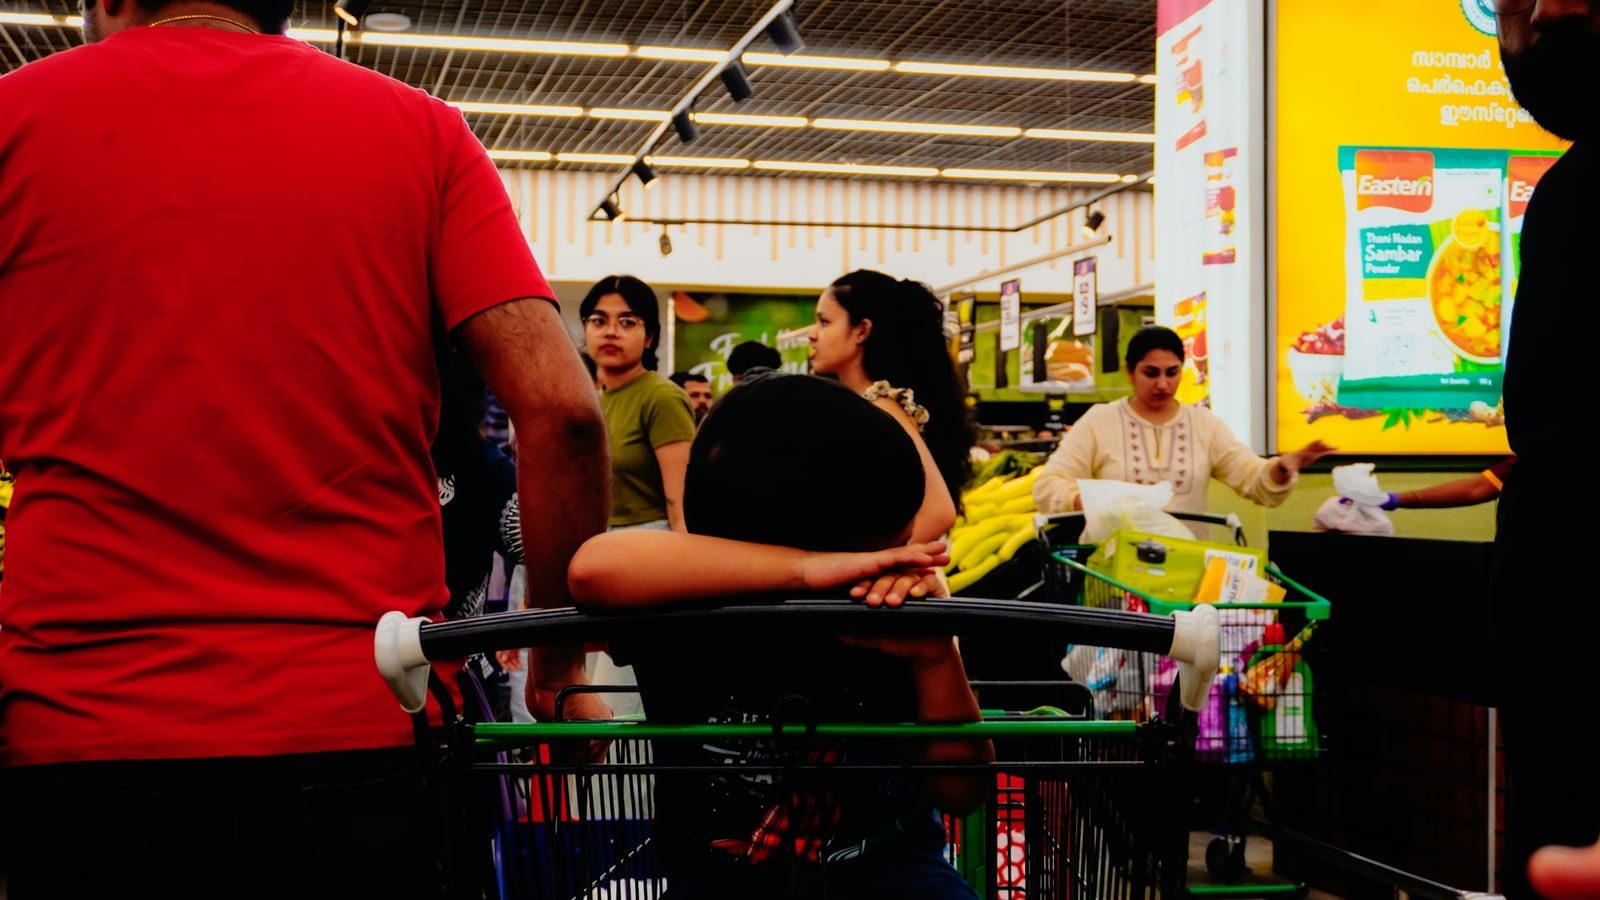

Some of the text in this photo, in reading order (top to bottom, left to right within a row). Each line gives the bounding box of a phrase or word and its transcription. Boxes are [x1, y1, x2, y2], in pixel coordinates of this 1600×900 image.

[1358, 174, 1432, 196] Eastern
[1511, 181, 1535, 202] Ea
[1366, 232, 1423, 244] Thani Nadan
[1365, 244, 1422, 262] Sambar
[1365, 263, 1400, 274] Powder
